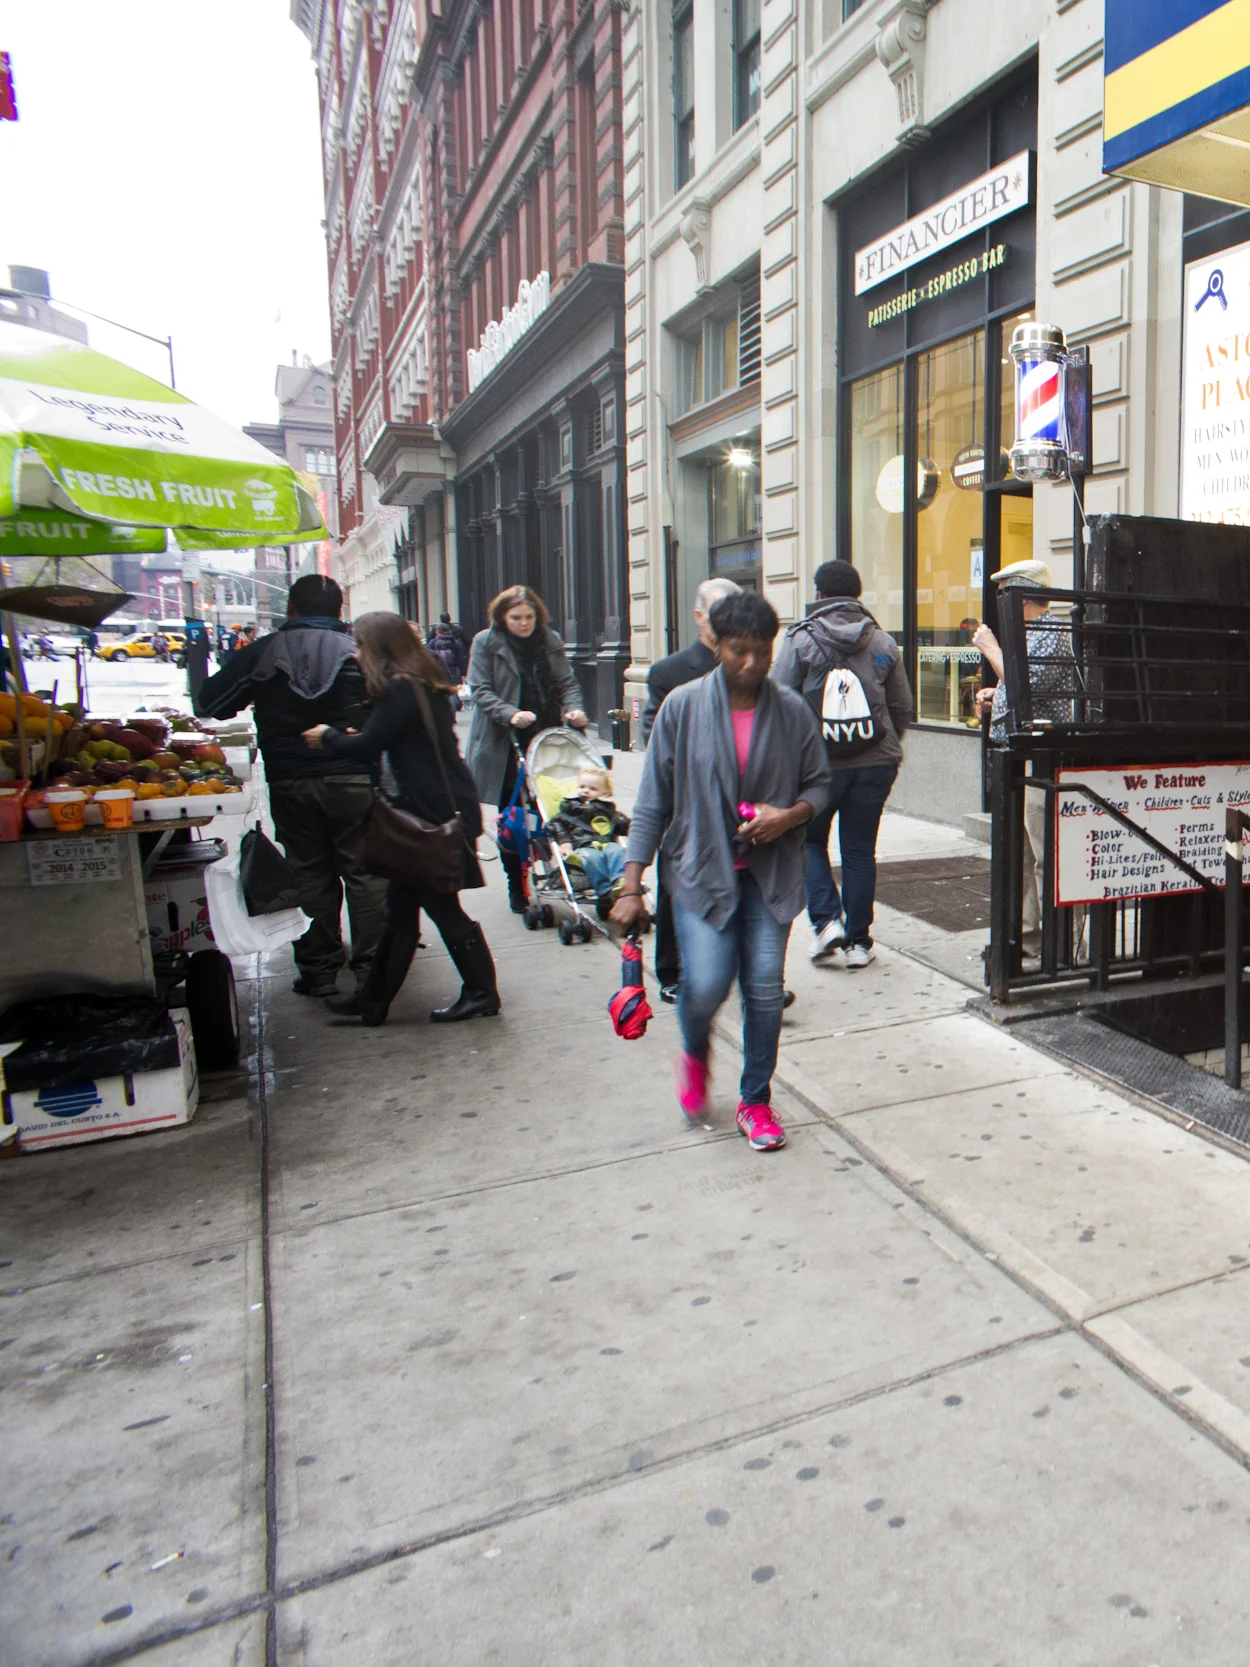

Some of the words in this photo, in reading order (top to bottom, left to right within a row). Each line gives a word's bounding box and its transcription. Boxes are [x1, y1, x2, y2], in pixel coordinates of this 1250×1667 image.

[864, 174, 1010, 281] FINANCIER
[868, 287, 917, 328] PATISSERIE
[928, 257, 978, 299] ESPRESSO
[982, 244, 1005, 272] BAR
[28, 388, 184, 431] Legendary
[86, 416, 190, 445] Service
[963, 474, 980, 486] COFFEE
[60, 468, 157, 502] FRESH
[160, 482, 237, 510] FRUIT
[0, 522, 92, 539] FRUIT
[973, 556, 982, 577] A
[920, 652, 946, 663] CATERING
[950, 652, 981, 663] ESPRESSO
[822, 720, 874, 743] NYU
[1124, 775, 1148, 791] We
[1154, 774, 1206, 789] Feature
[1060, 801, 1087, 815] Men
[1144, 797, 1183, 808] Children
[1190, 795, 1211, 805] Cuts
[1216, 793, 1223, 803] &
[1180, 823, 1214, 834] Perms
[1092, 842, 1123, 855] Color
[1180, 834, 1226, 847] Relaxers
[1179, 846, 1222, 860] Braiding
[48, 863, 74, 874] 2014
[81, 861, 107, 872] 2015
[1090, 867, 1117, 880] Hair
[1122, 865, 1165, 879] Designs
[1103, 881, 1157, 898] Brazilian
[51, 1119, 69, 1128] DEL
[72, 1114, 104, 1125] CURTO
